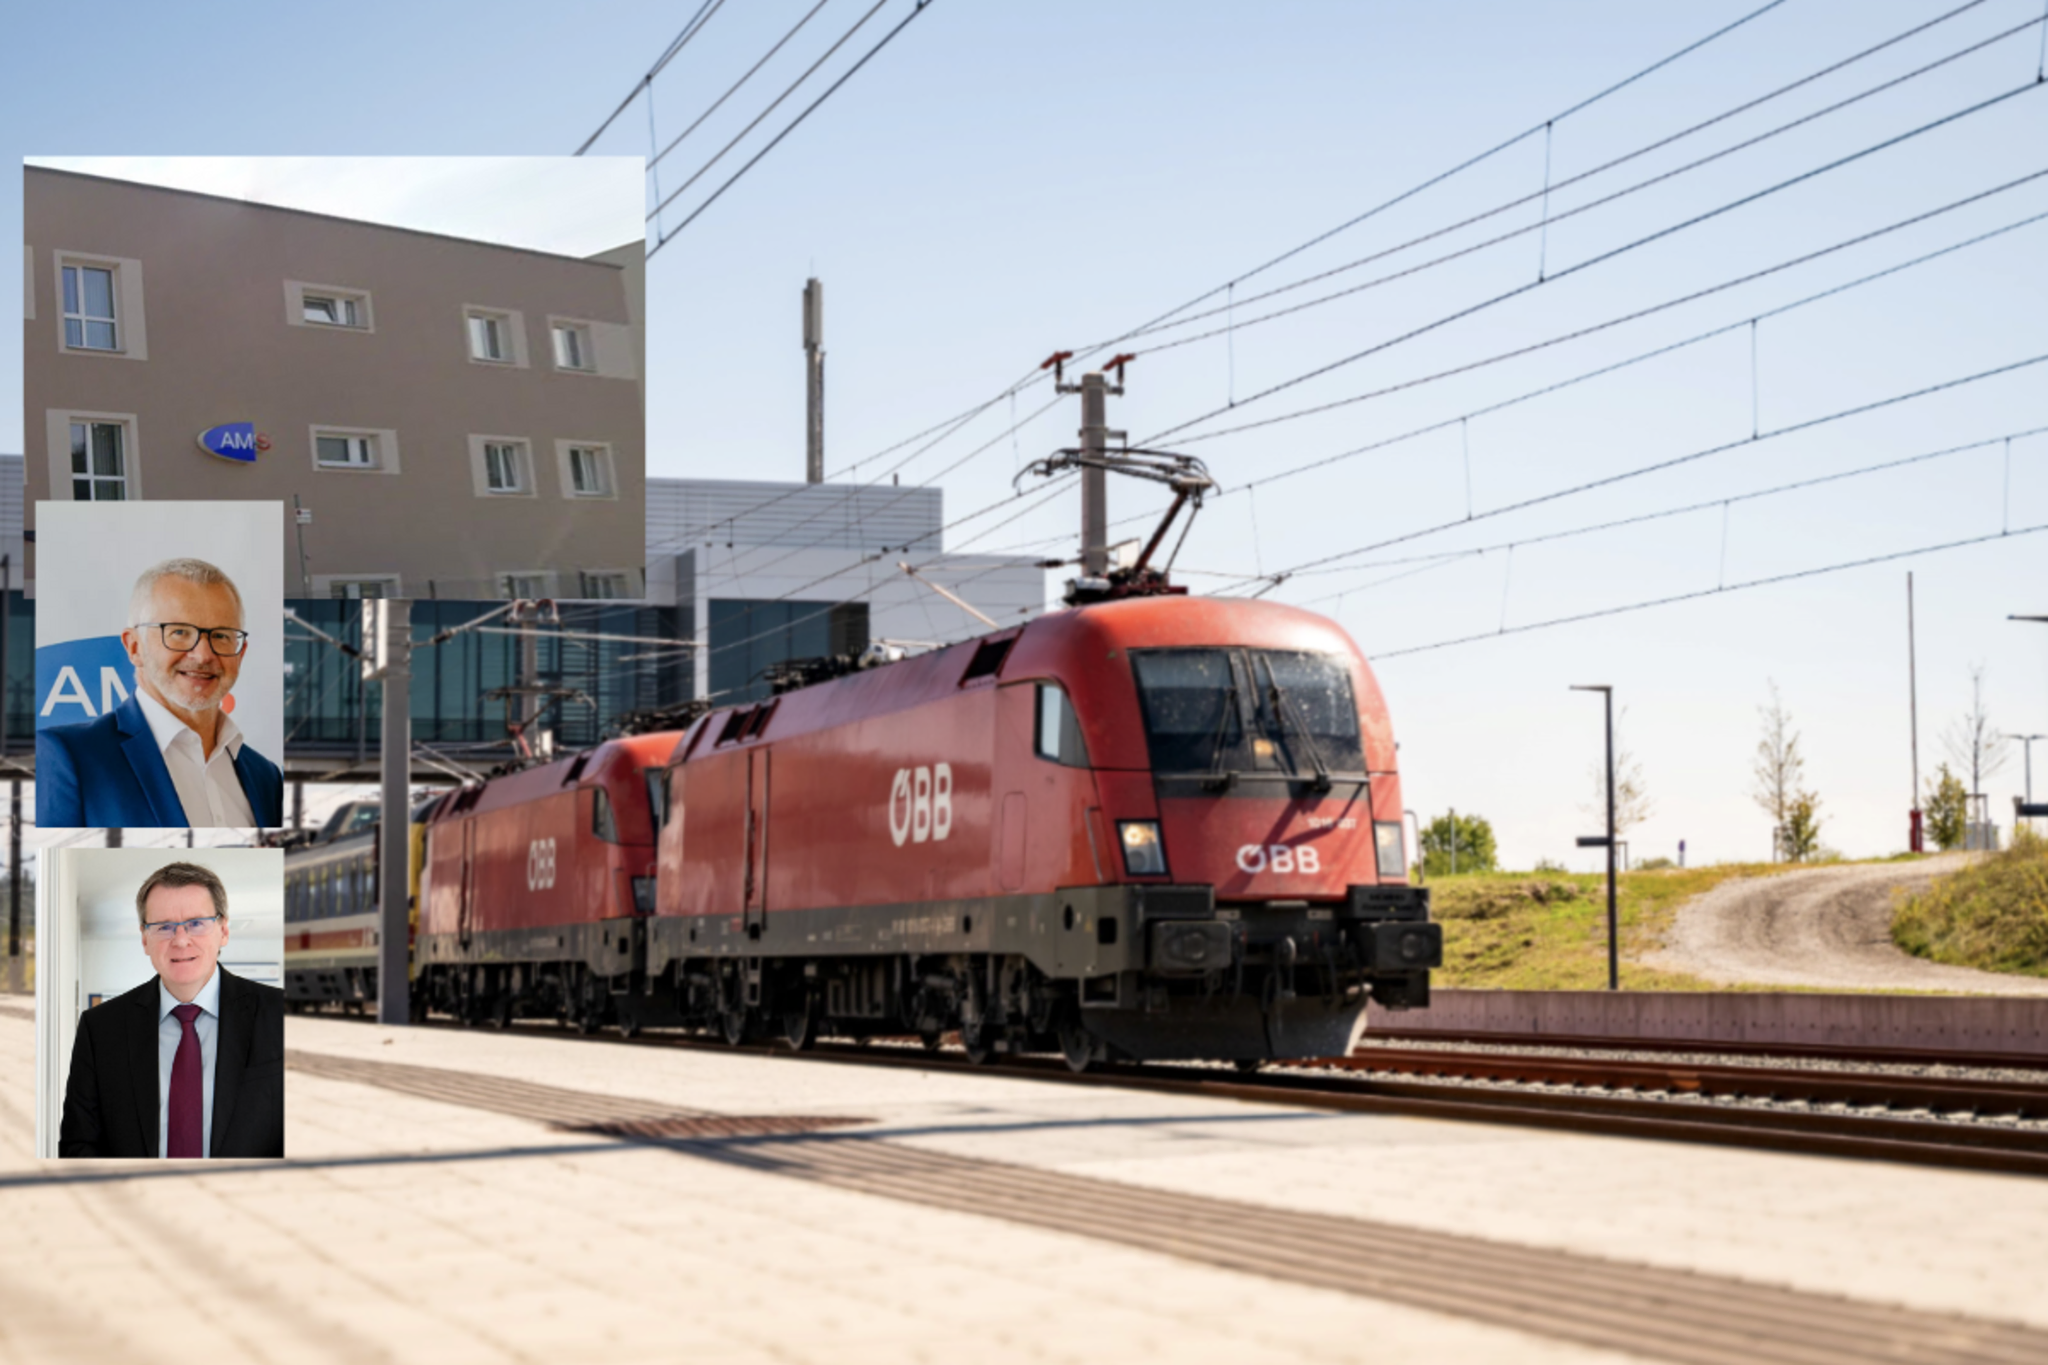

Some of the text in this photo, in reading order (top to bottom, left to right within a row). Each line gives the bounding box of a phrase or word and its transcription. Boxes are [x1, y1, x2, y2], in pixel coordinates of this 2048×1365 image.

[220, 432, 271, 450] AMS
[889, 762, 953, 847] ÖBB
[1236, 843, 1321, 873] ÖBB
